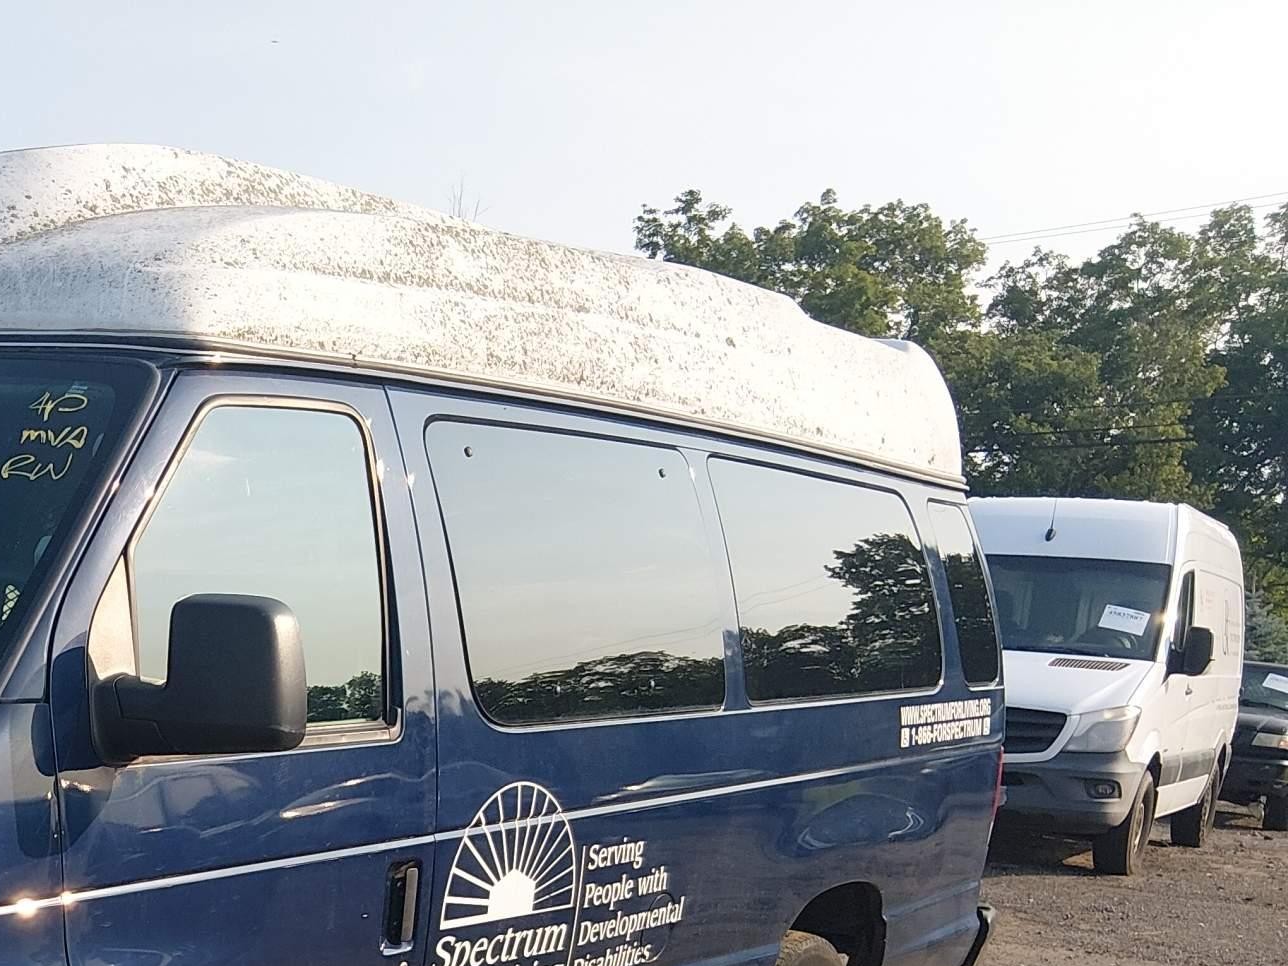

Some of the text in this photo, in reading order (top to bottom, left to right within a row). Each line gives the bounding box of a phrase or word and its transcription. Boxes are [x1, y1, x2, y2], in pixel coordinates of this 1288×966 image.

[0, 452, 73, 481] RW
[900, 697, 991, 726] WWW.SPECTRUMFORLIVING.ORG
[911, 718, 983, 746] 1-866-FORSPECTRUM
[587, 837, 645, 870] Serving
[582, 866, 668, 910] People with
[577, 897, 684, 945] Developmental
